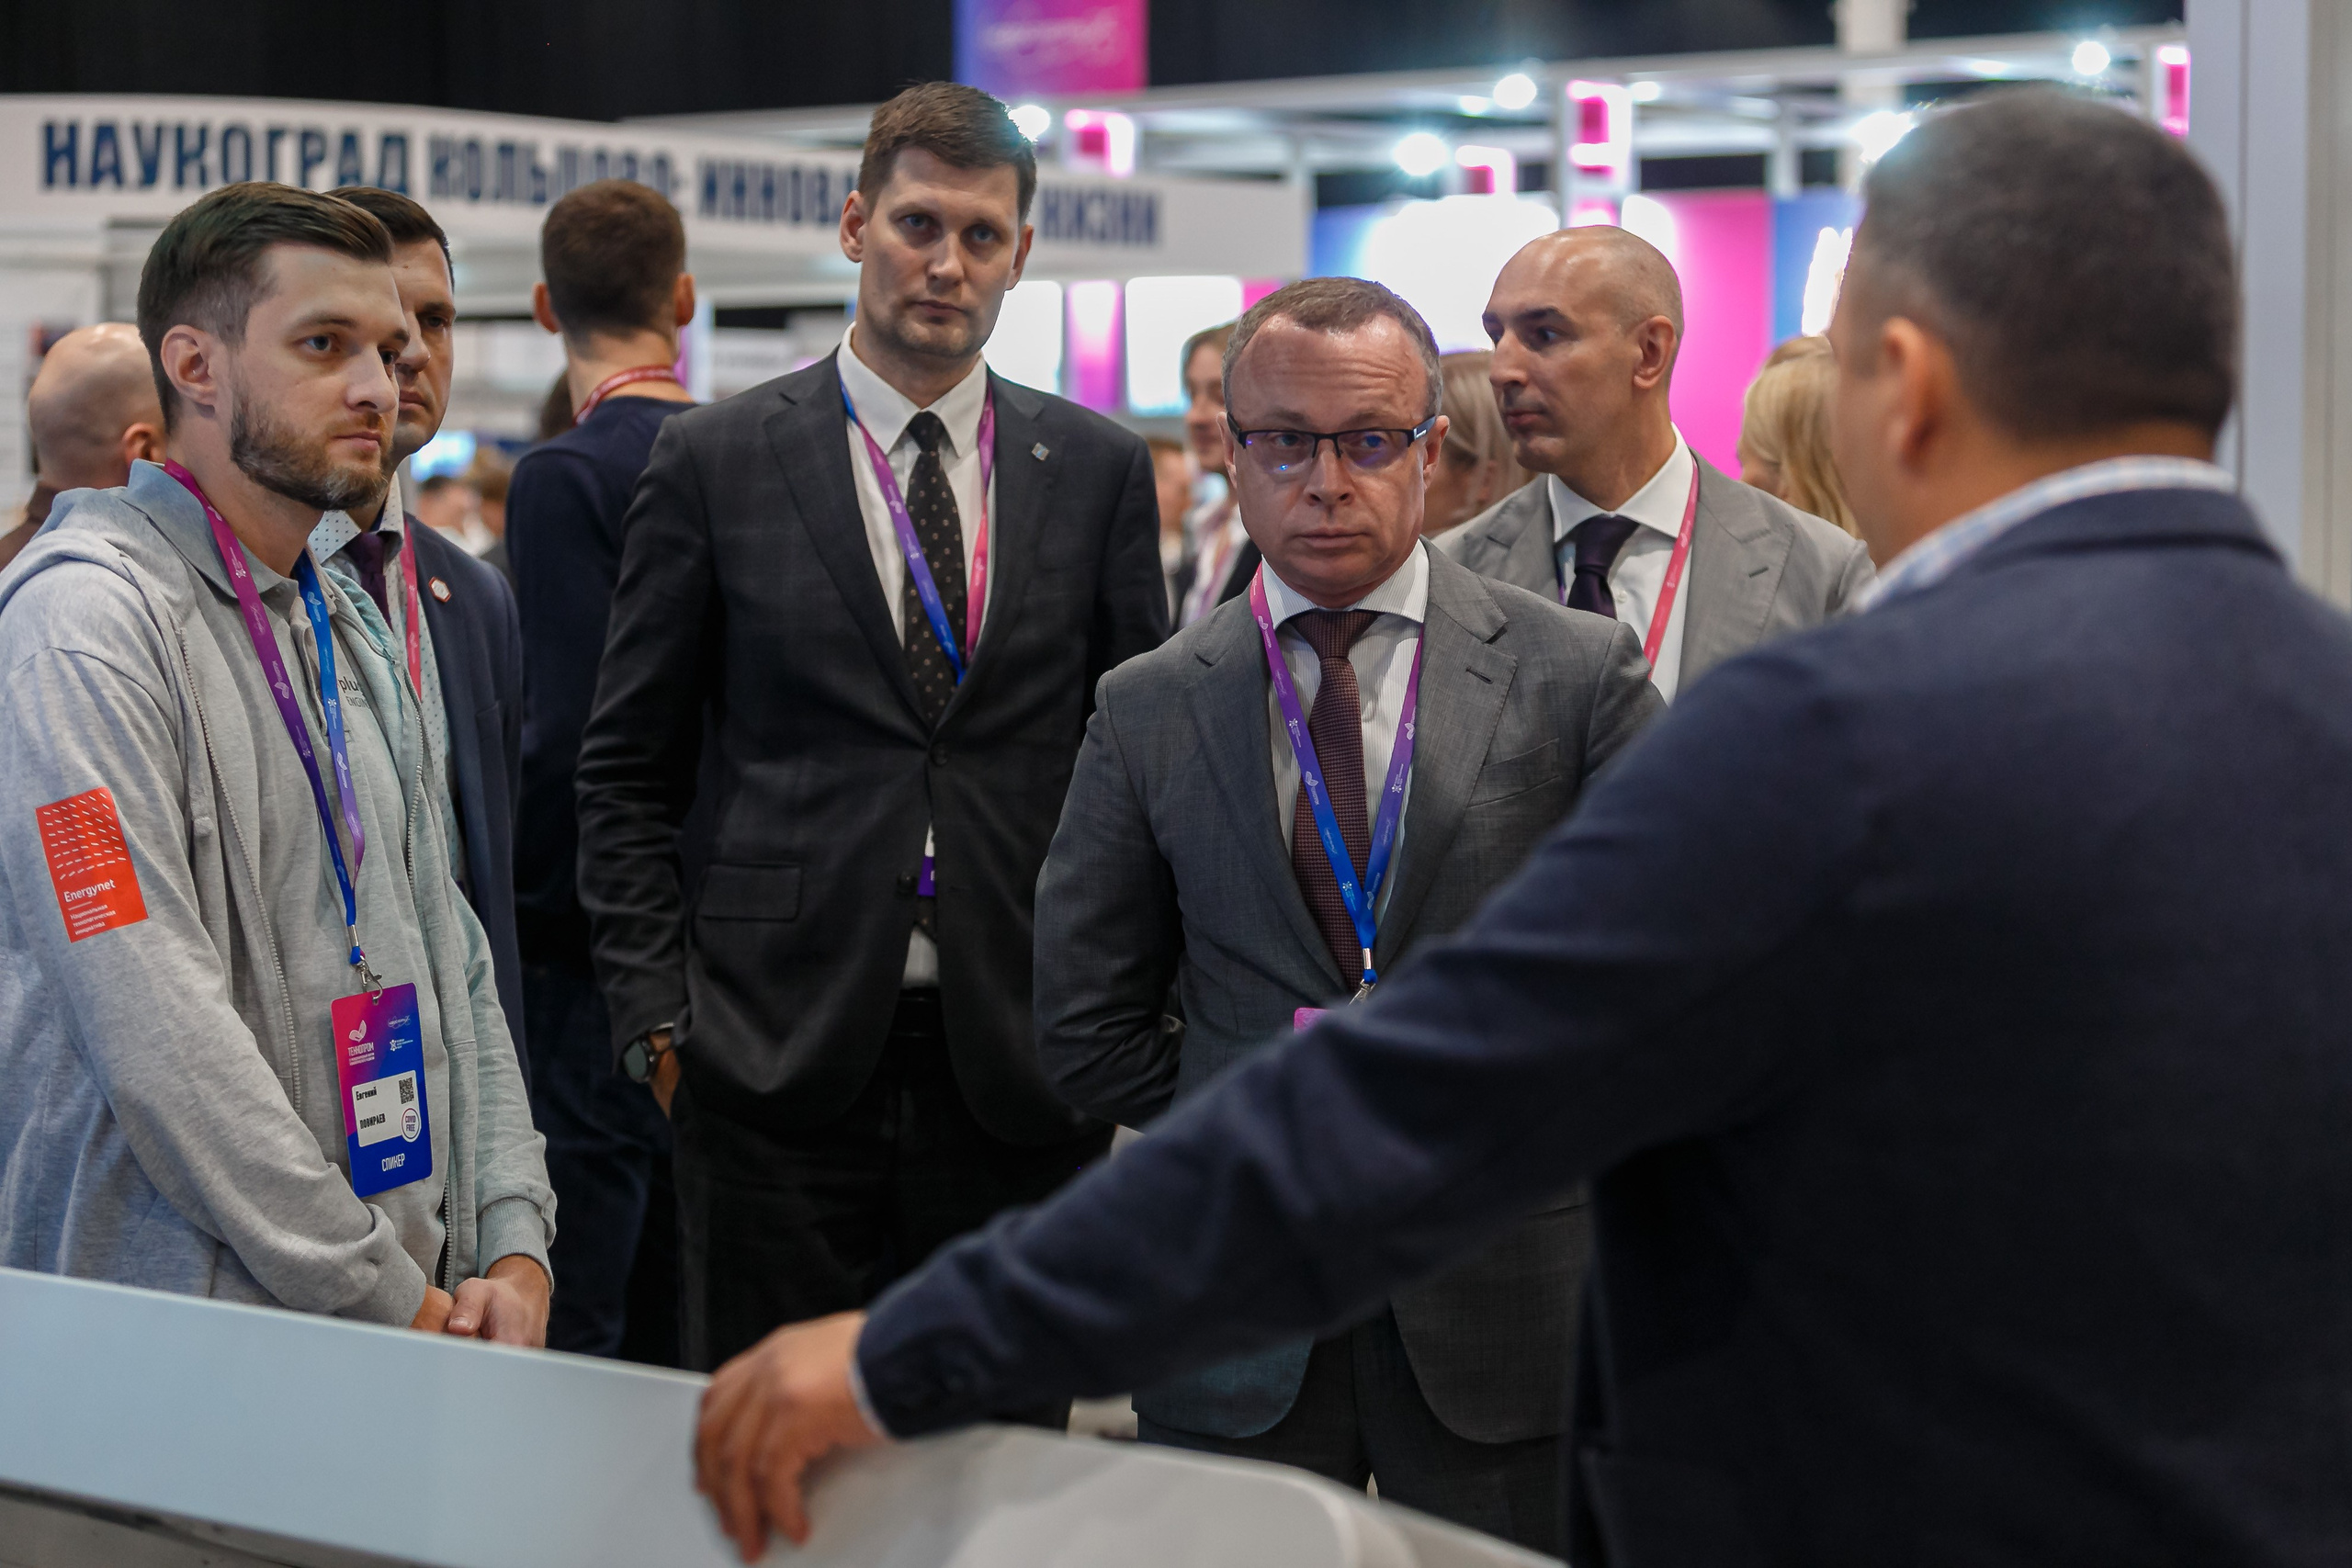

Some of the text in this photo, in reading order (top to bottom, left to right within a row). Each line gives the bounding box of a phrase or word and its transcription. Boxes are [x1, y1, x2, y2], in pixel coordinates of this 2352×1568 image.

[40, 120, 412, 197] НАУКОГРАД
[696, 158, 862, 224] ИННОВА
[338, 676, 359, 694] plu
[345, 696, 370, 709] ENGIN
[63, 878, 116, 903] Energynet
[347, 1042, 375, 1056] ТЕХНОПРОМ
[356, 1086, 378, 1100] Евгений
[405, 1115, 416, 1123] COVID
[406, 1123, 415, 1132] FREE
[381, 1153, 405, 1172] СПИКЕР
